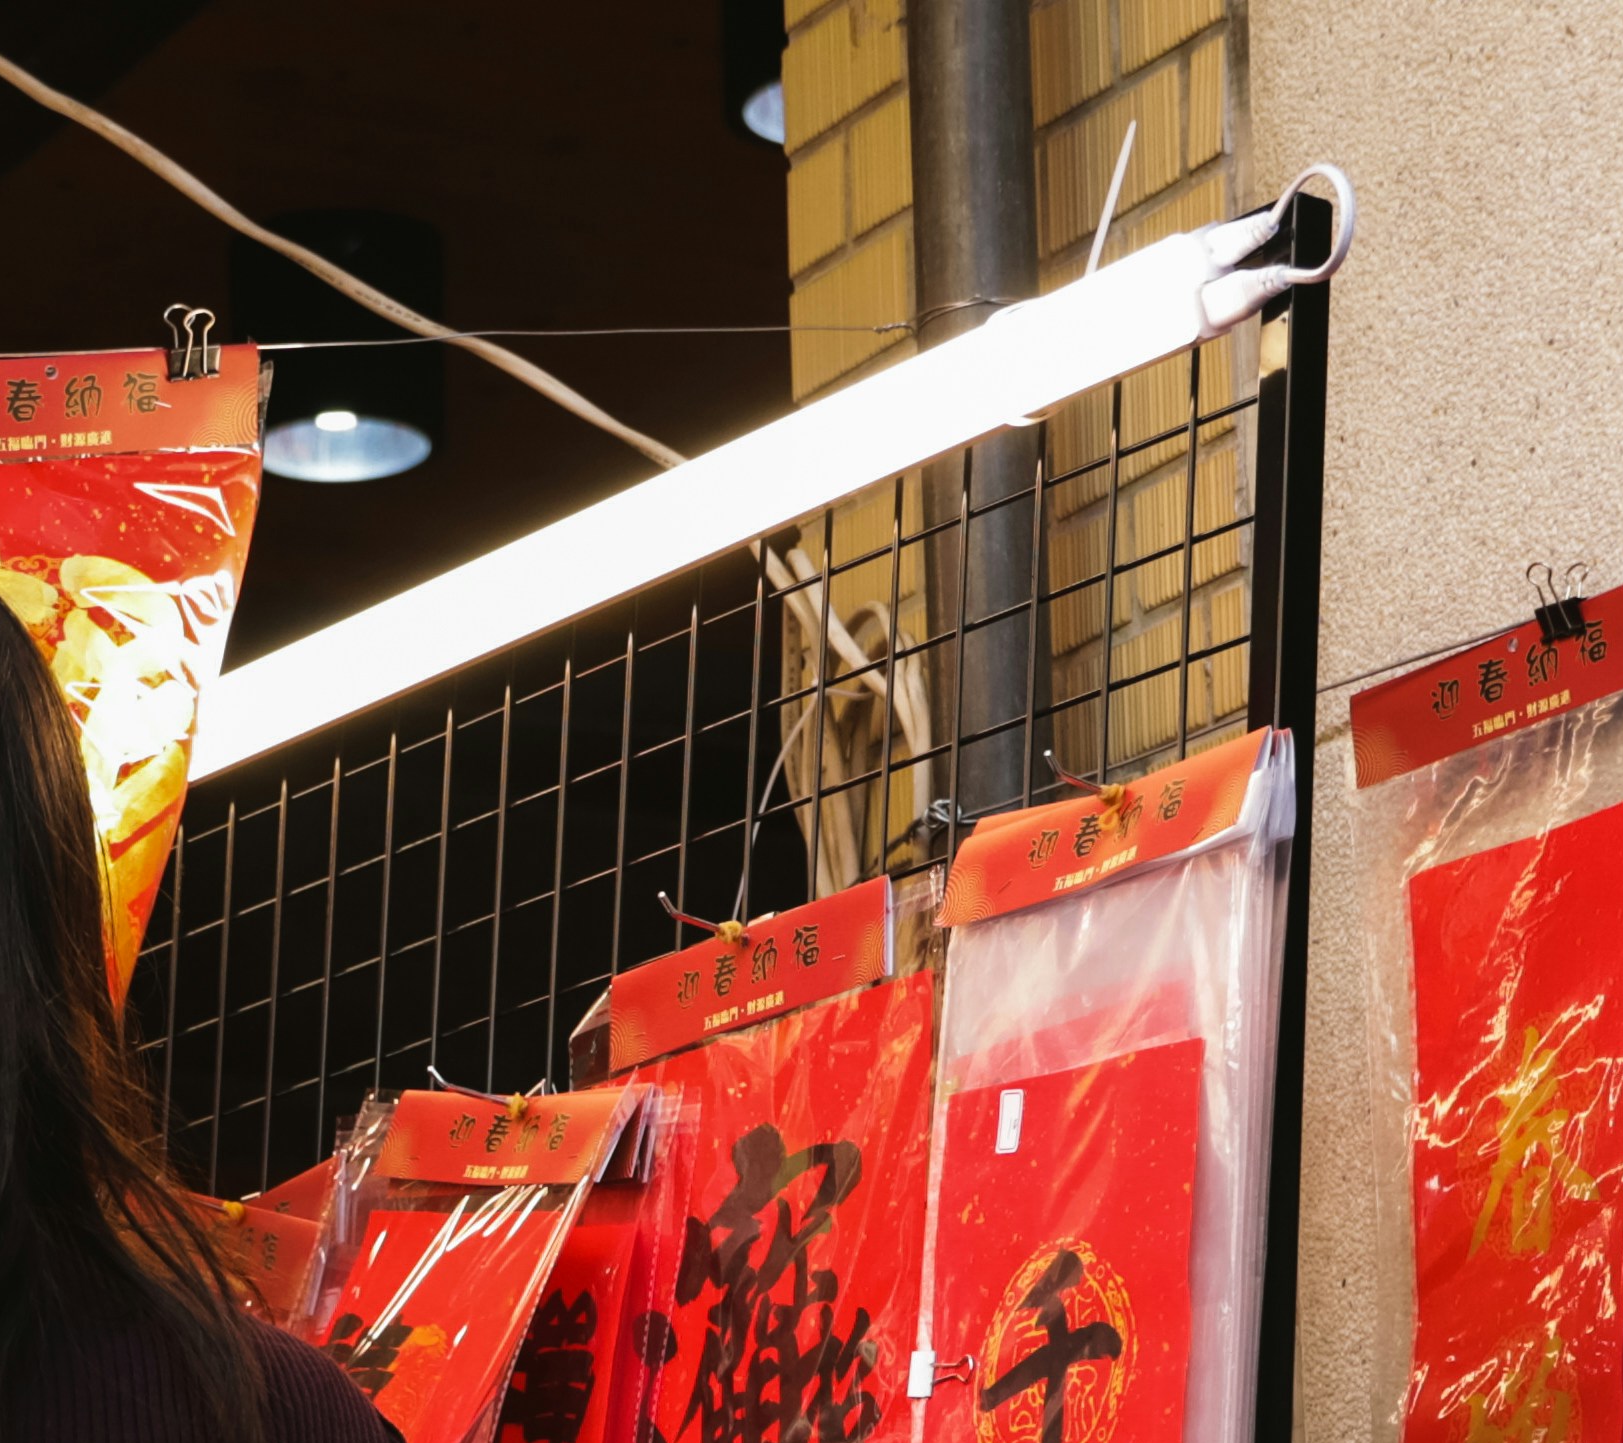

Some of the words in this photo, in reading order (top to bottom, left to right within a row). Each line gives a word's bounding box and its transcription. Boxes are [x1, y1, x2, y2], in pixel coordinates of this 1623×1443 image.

[1431, 619, 1609, 720] 迎春納福
[1028, 779, 1187, 868] 迎春納福
[677, 925, 821, 1009] 迎春納福
[448, 1113, 571, 1153] 迎春納福
